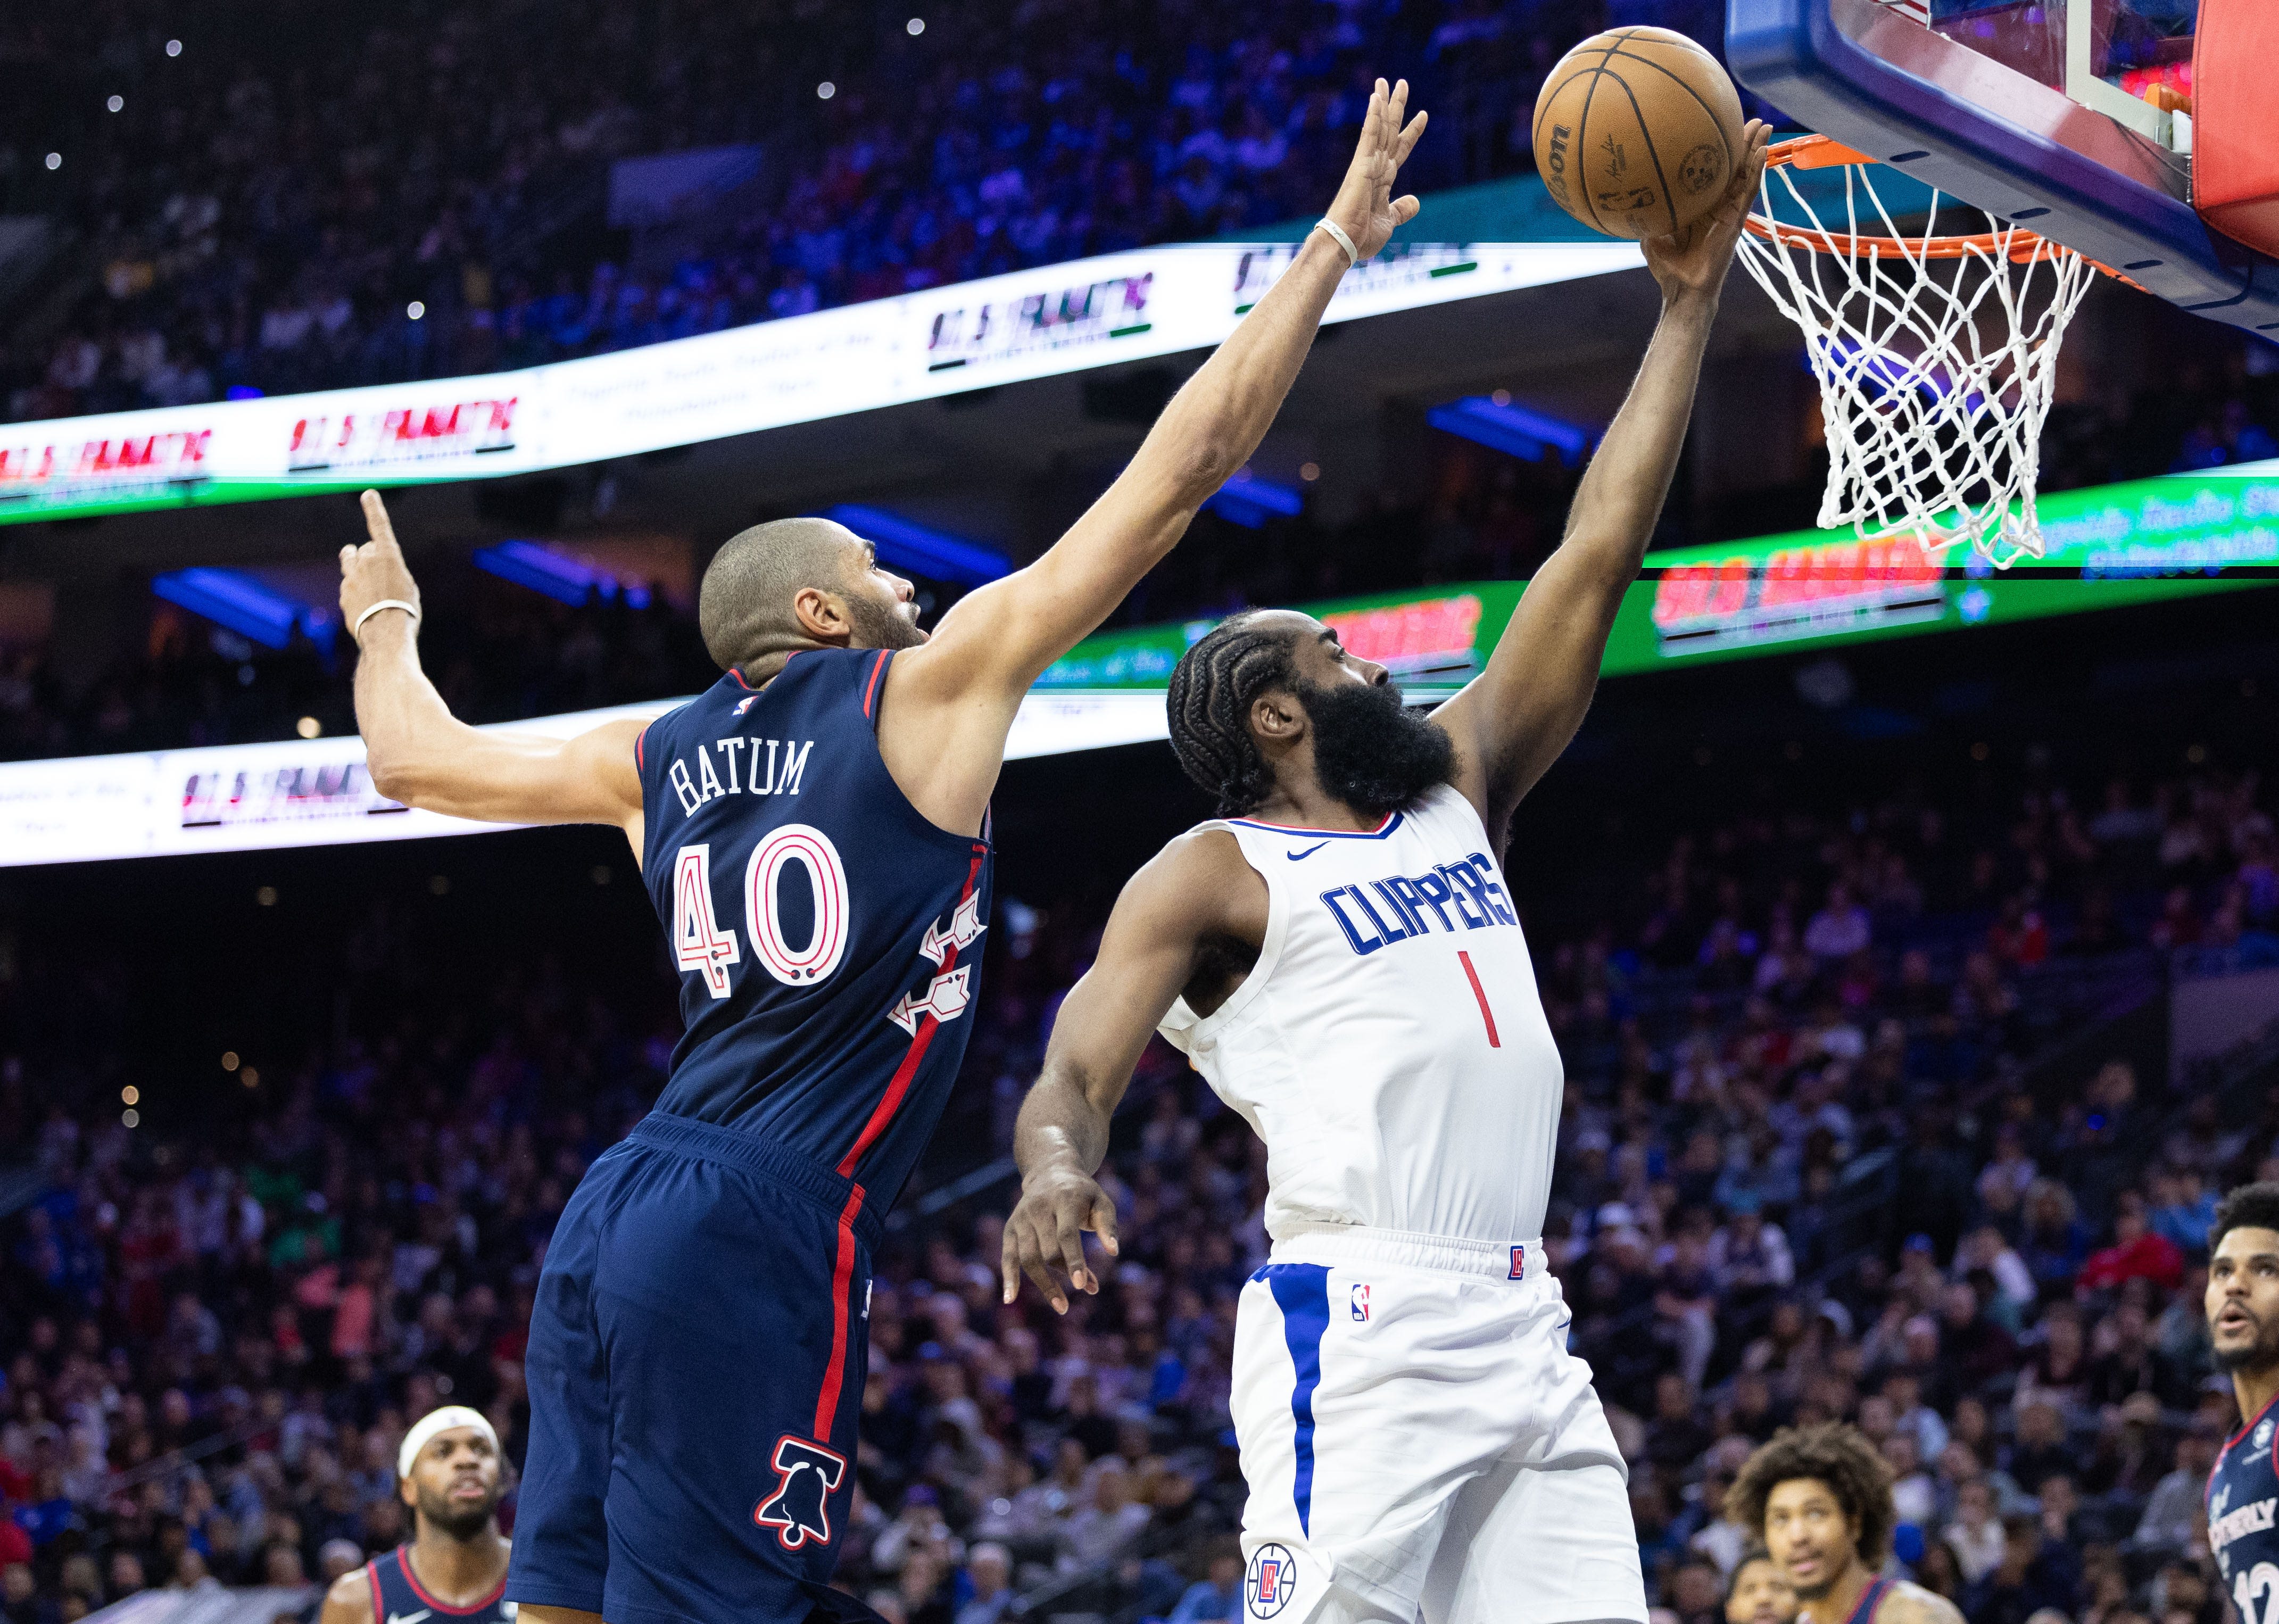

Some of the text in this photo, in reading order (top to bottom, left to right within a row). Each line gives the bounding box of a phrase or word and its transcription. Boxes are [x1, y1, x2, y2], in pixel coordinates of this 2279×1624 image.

[669, 736, 814, 818] BATUM
[674, 823, 849, 999] 40
[1320, 852, 1517, 956] CLIPPERS
[1457, 951, 1501, 1048] 1
